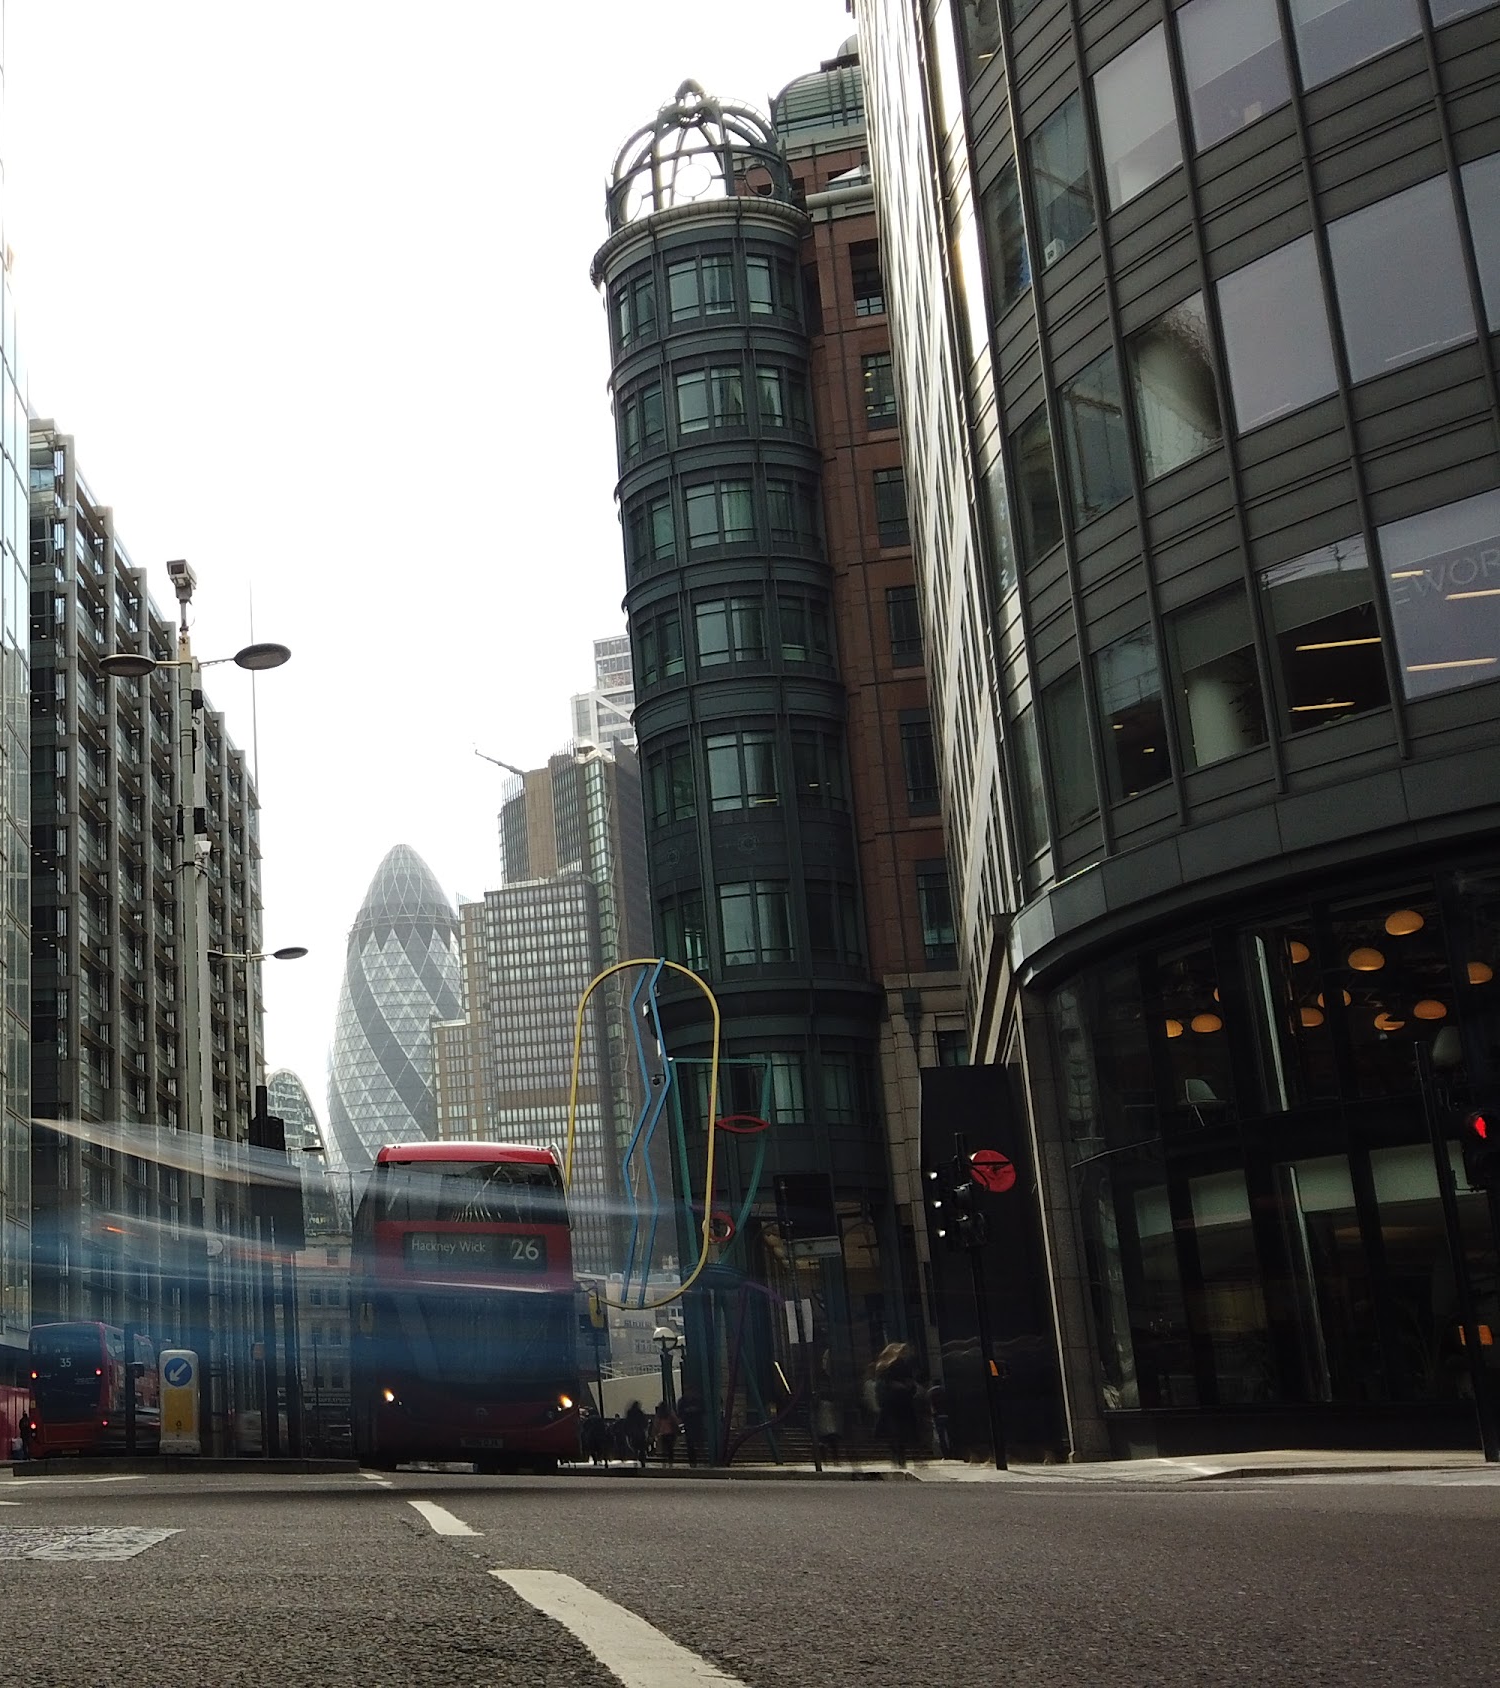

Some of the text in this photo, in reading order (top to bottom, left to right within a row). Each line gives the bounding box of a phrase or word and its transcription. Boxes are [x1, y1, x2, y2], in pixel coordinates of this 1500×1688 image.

[411, 1239, 486, 1255] Hackney Wick
[512, 1239, 539, 1261] 26
[60, 1357, 72, 1368] 35
